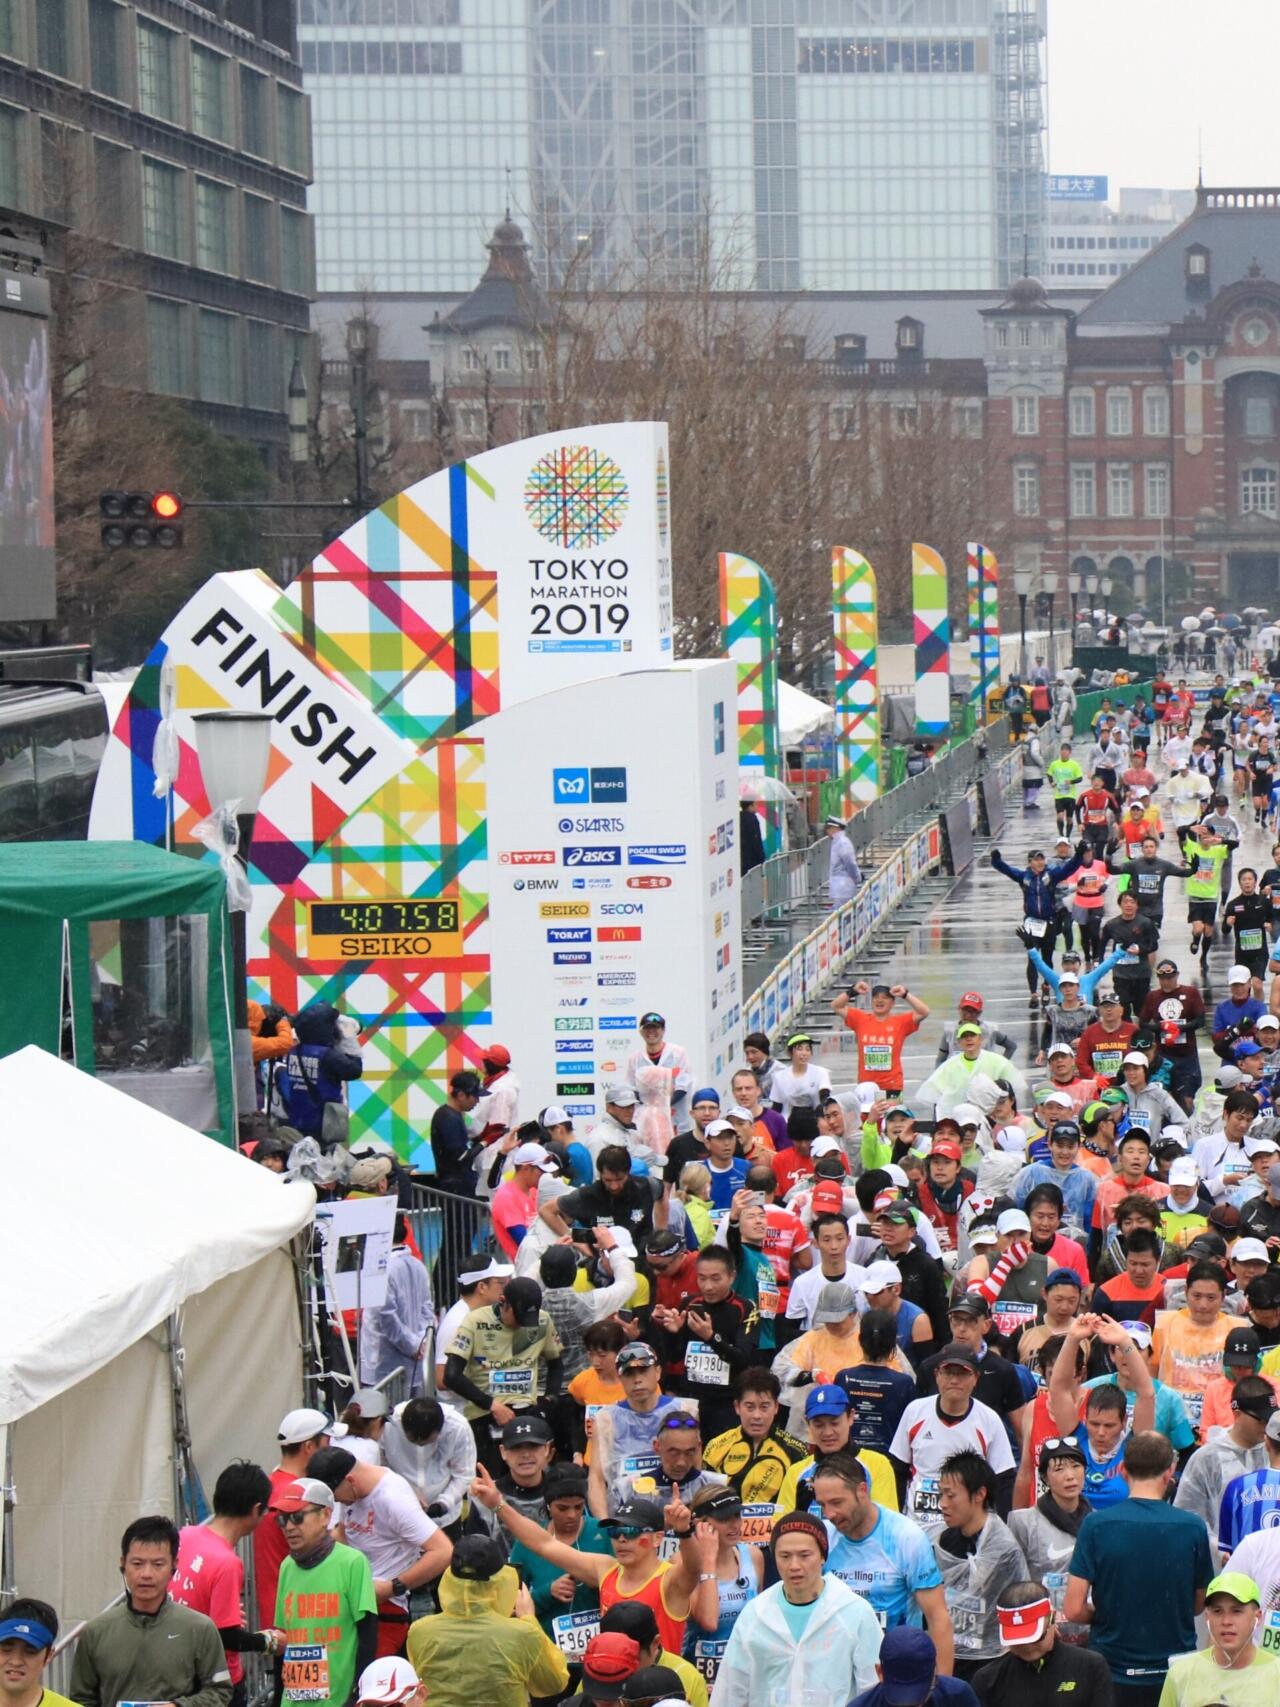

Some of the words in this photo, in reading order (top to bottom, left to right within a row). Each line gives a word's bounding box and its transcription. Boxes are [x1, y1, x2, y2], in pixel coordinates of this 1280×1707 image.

[529, 559, 628, 580] TOKYO
[531, 586, 627, 598] MARATHON
[531, 604, 629, 634] 2019
[190, 607, 377, 785] FINISH
[576, 818, 624, 832] STARTS
[582, 848, 615, 863] asics
[629, 847, 656, 855] POCARI
[659, 846, 685, 854] SWEAT
[513, 852, 554, 863] ヤマザキ
[527, 879, 559, 890] BMW
[631, 878, 667, 887] 第一生命
[541, 904, 589, 916] SEIKO
[601, 903, 643, 915] SECOM
[341, 937, 431, 956] SEIKO
[1096, 1042, 1128, 1051] TROJANS
[563, 1084, 589, 1094] hulu
[743, 1518, 771, 1535] 2624
[297, 1592, 338, 1618] DASH
[290, 1649, 320, 1657] 東京メトロ
